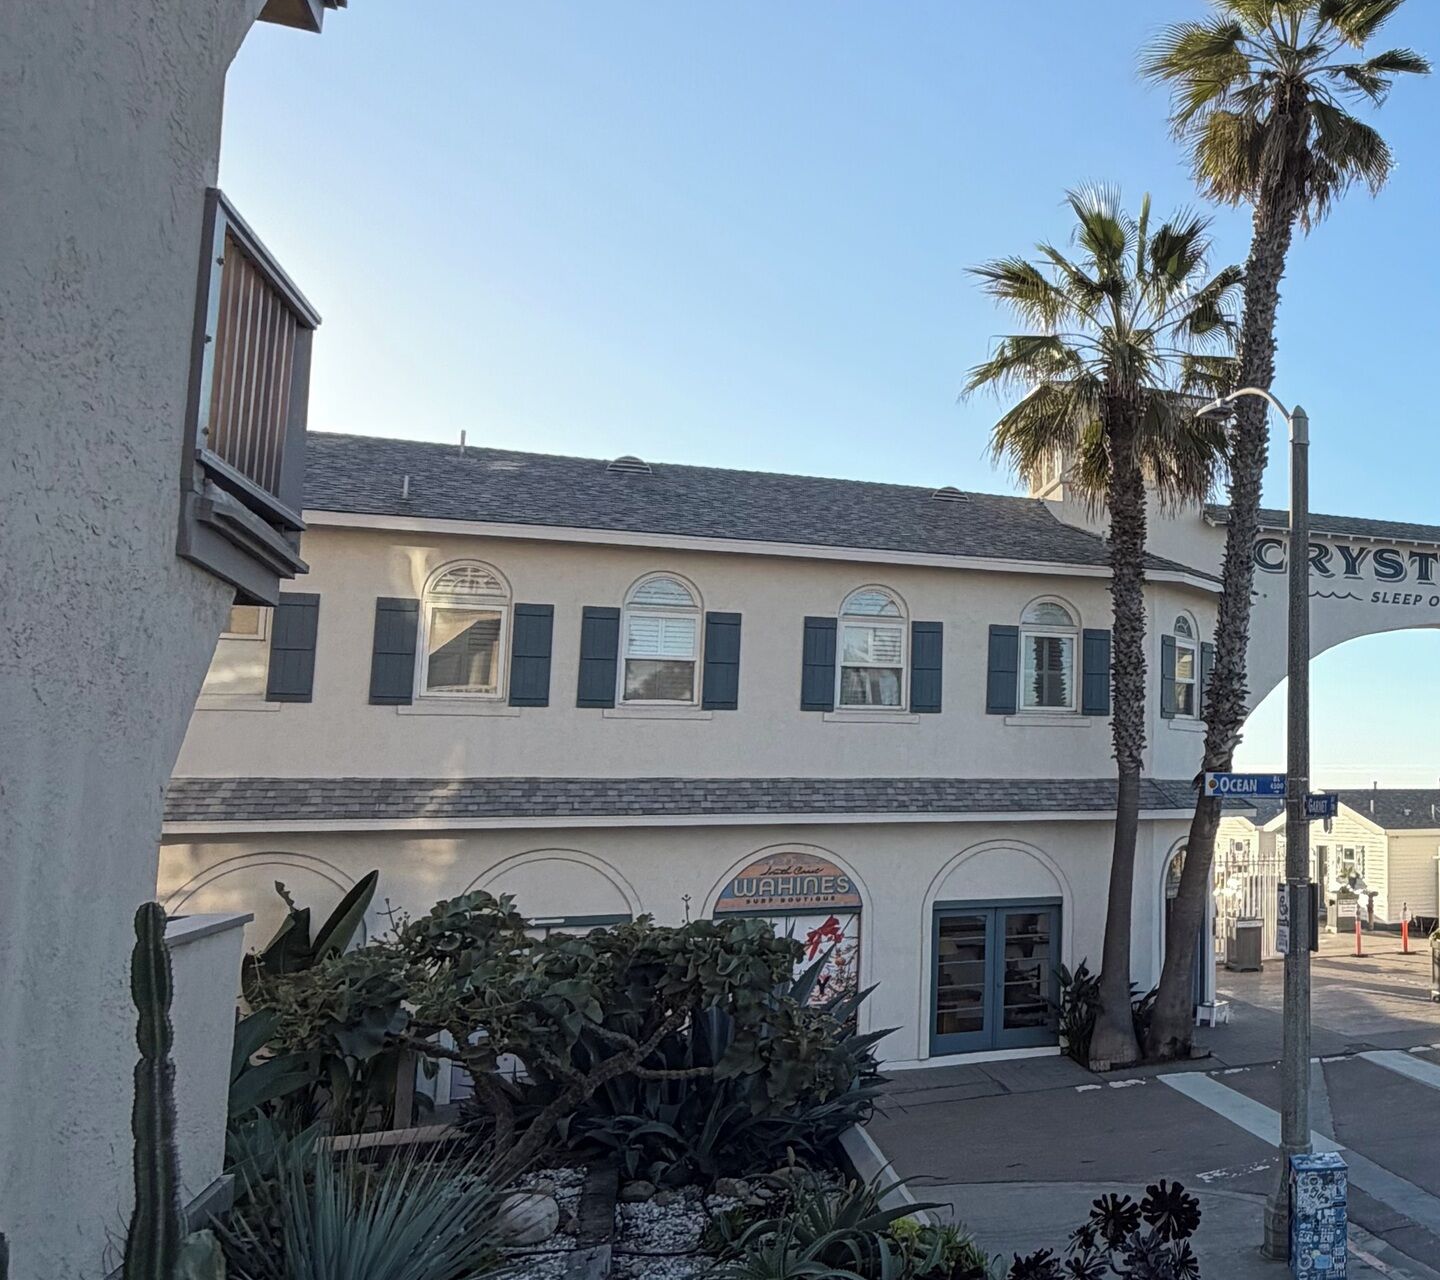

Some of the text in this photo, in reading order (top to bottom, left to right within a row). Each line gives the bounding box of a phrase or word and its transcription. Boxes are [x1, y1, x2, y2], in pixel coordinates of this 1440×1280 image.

[1371, 591, 1423, 606] SLEEP
[1220, 776, 1257, 792] OCEAN
[760, 865, 824, 876] South Coast
[733, 876, 849, 897] WAHINES
[780, 895, 836, 903] BOUTIQUE
